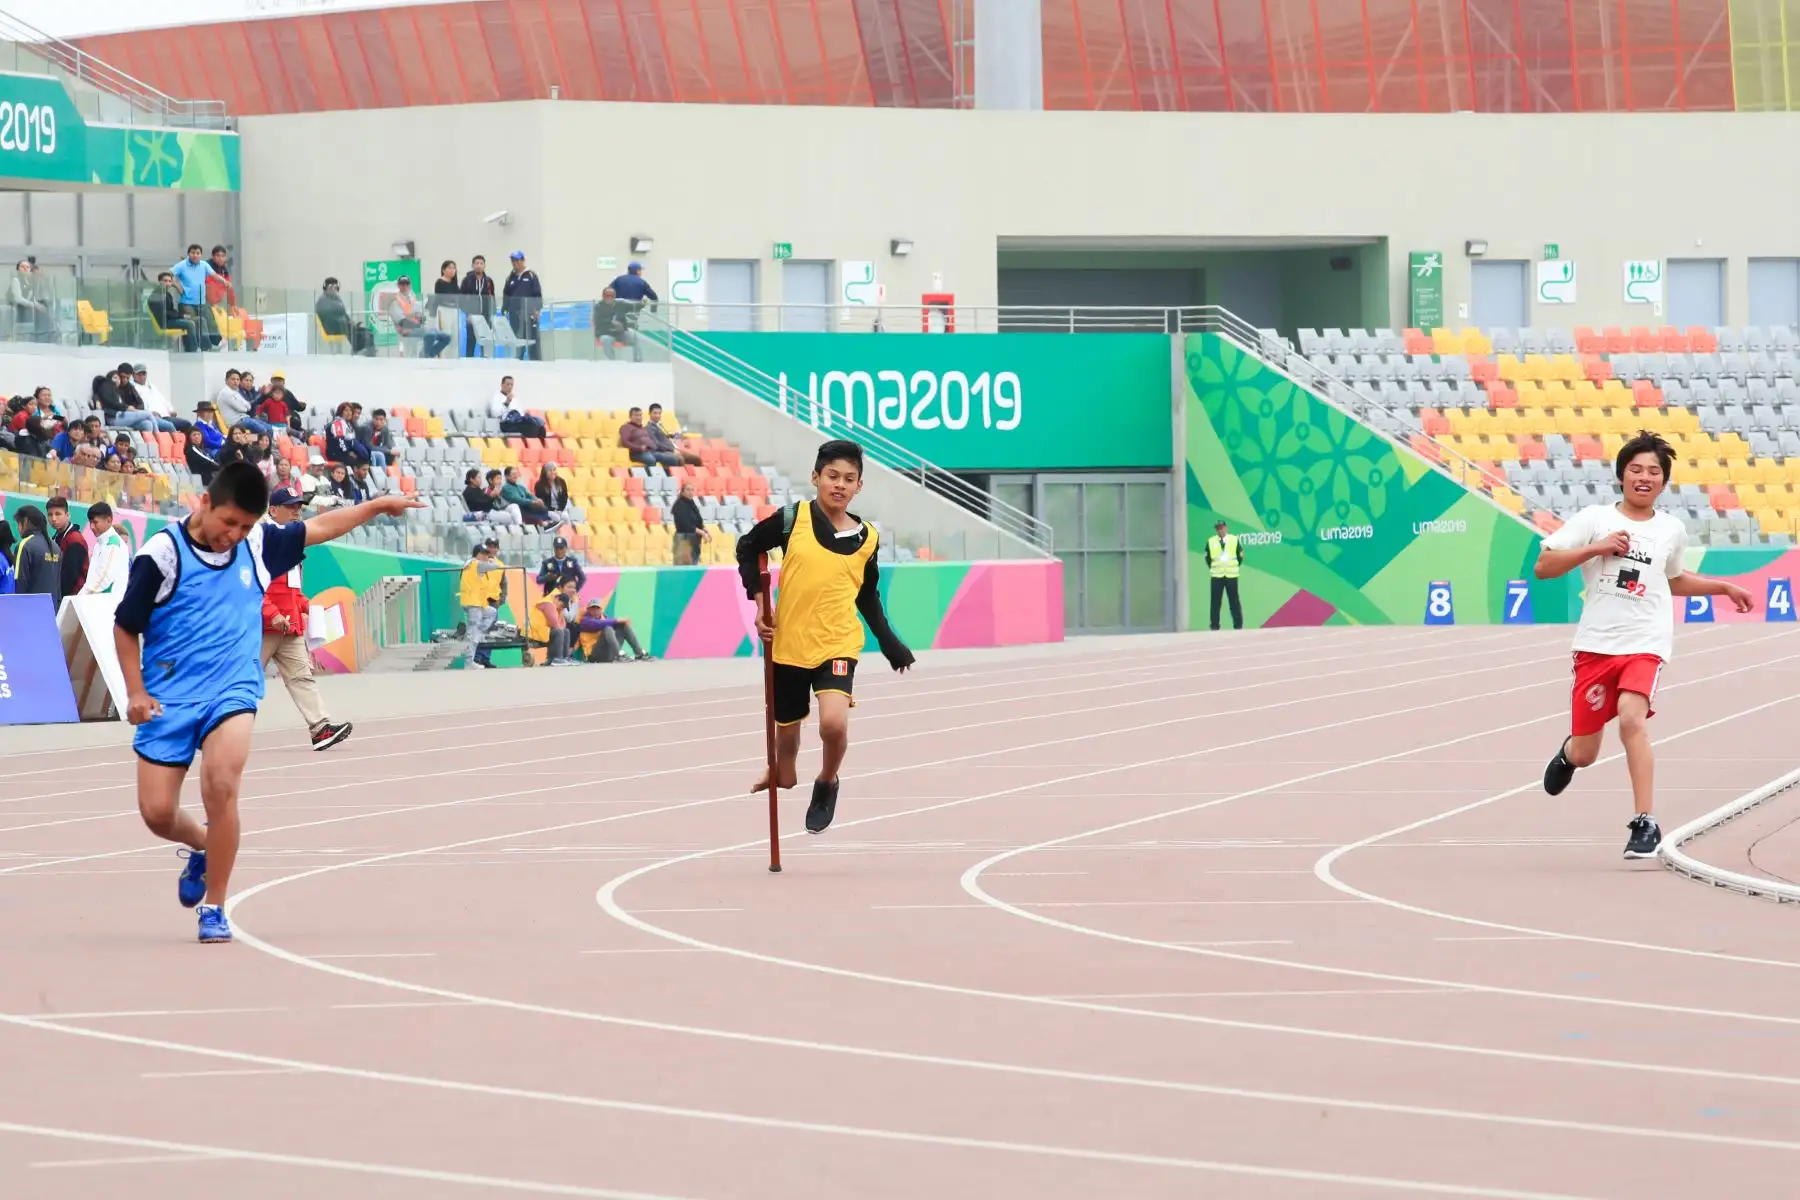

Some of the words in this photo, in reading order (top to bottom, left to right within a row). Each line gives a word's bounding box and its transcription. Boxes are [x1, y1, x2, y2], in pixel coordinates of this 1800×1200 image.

[0, 101, 56, 154] 2019
[1429, 587, 1451, 617] 8
[1508, 587, 1529, 618] 7
[1626, 579, 1647, 597] 92
[1768, 584, 1791, 615] 4
